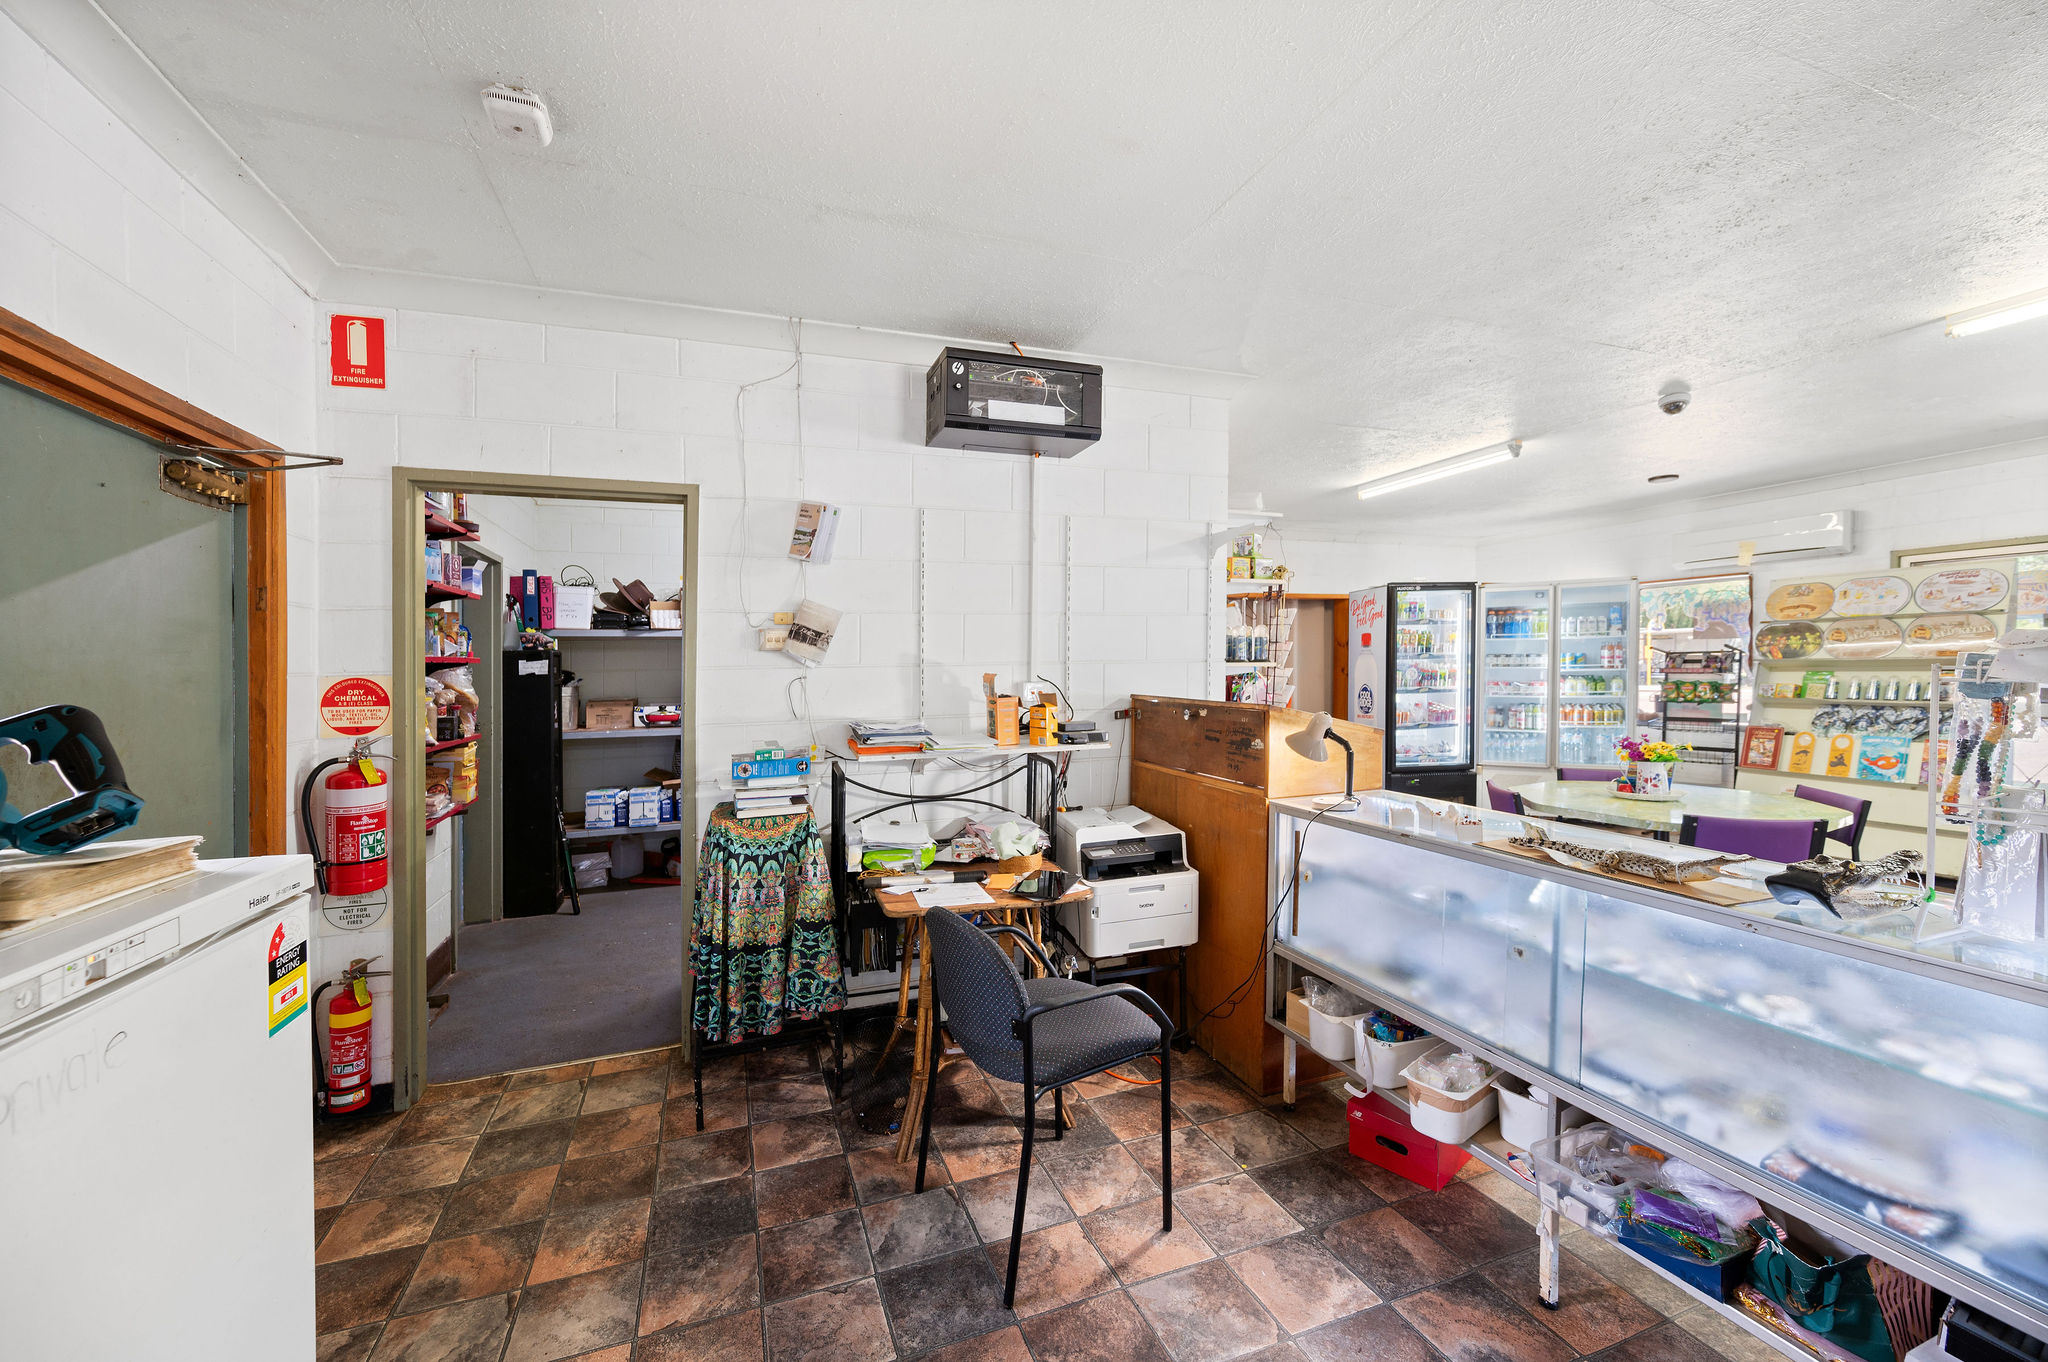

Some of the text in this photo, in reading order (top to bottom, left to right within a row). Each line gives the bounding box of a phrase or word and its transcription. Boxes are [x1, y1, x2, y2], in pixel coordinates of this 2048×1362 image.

[333, 375, 384, 384] EXTINGUISHER
[542, 606, 552, 621] BP
[1351, 599, 1361, 616] Do
[1356, 613, 1368, 629] Feel
[326, 680, 385, 698] THIS COLOURED EXTINGUISHER
[248, 893, 270, 909] Haier
[338, 913, 372, 921] ELECTRICAL
[275, 945, 301, 968] ENERGY
[276, 957, 301, 979] RATING
